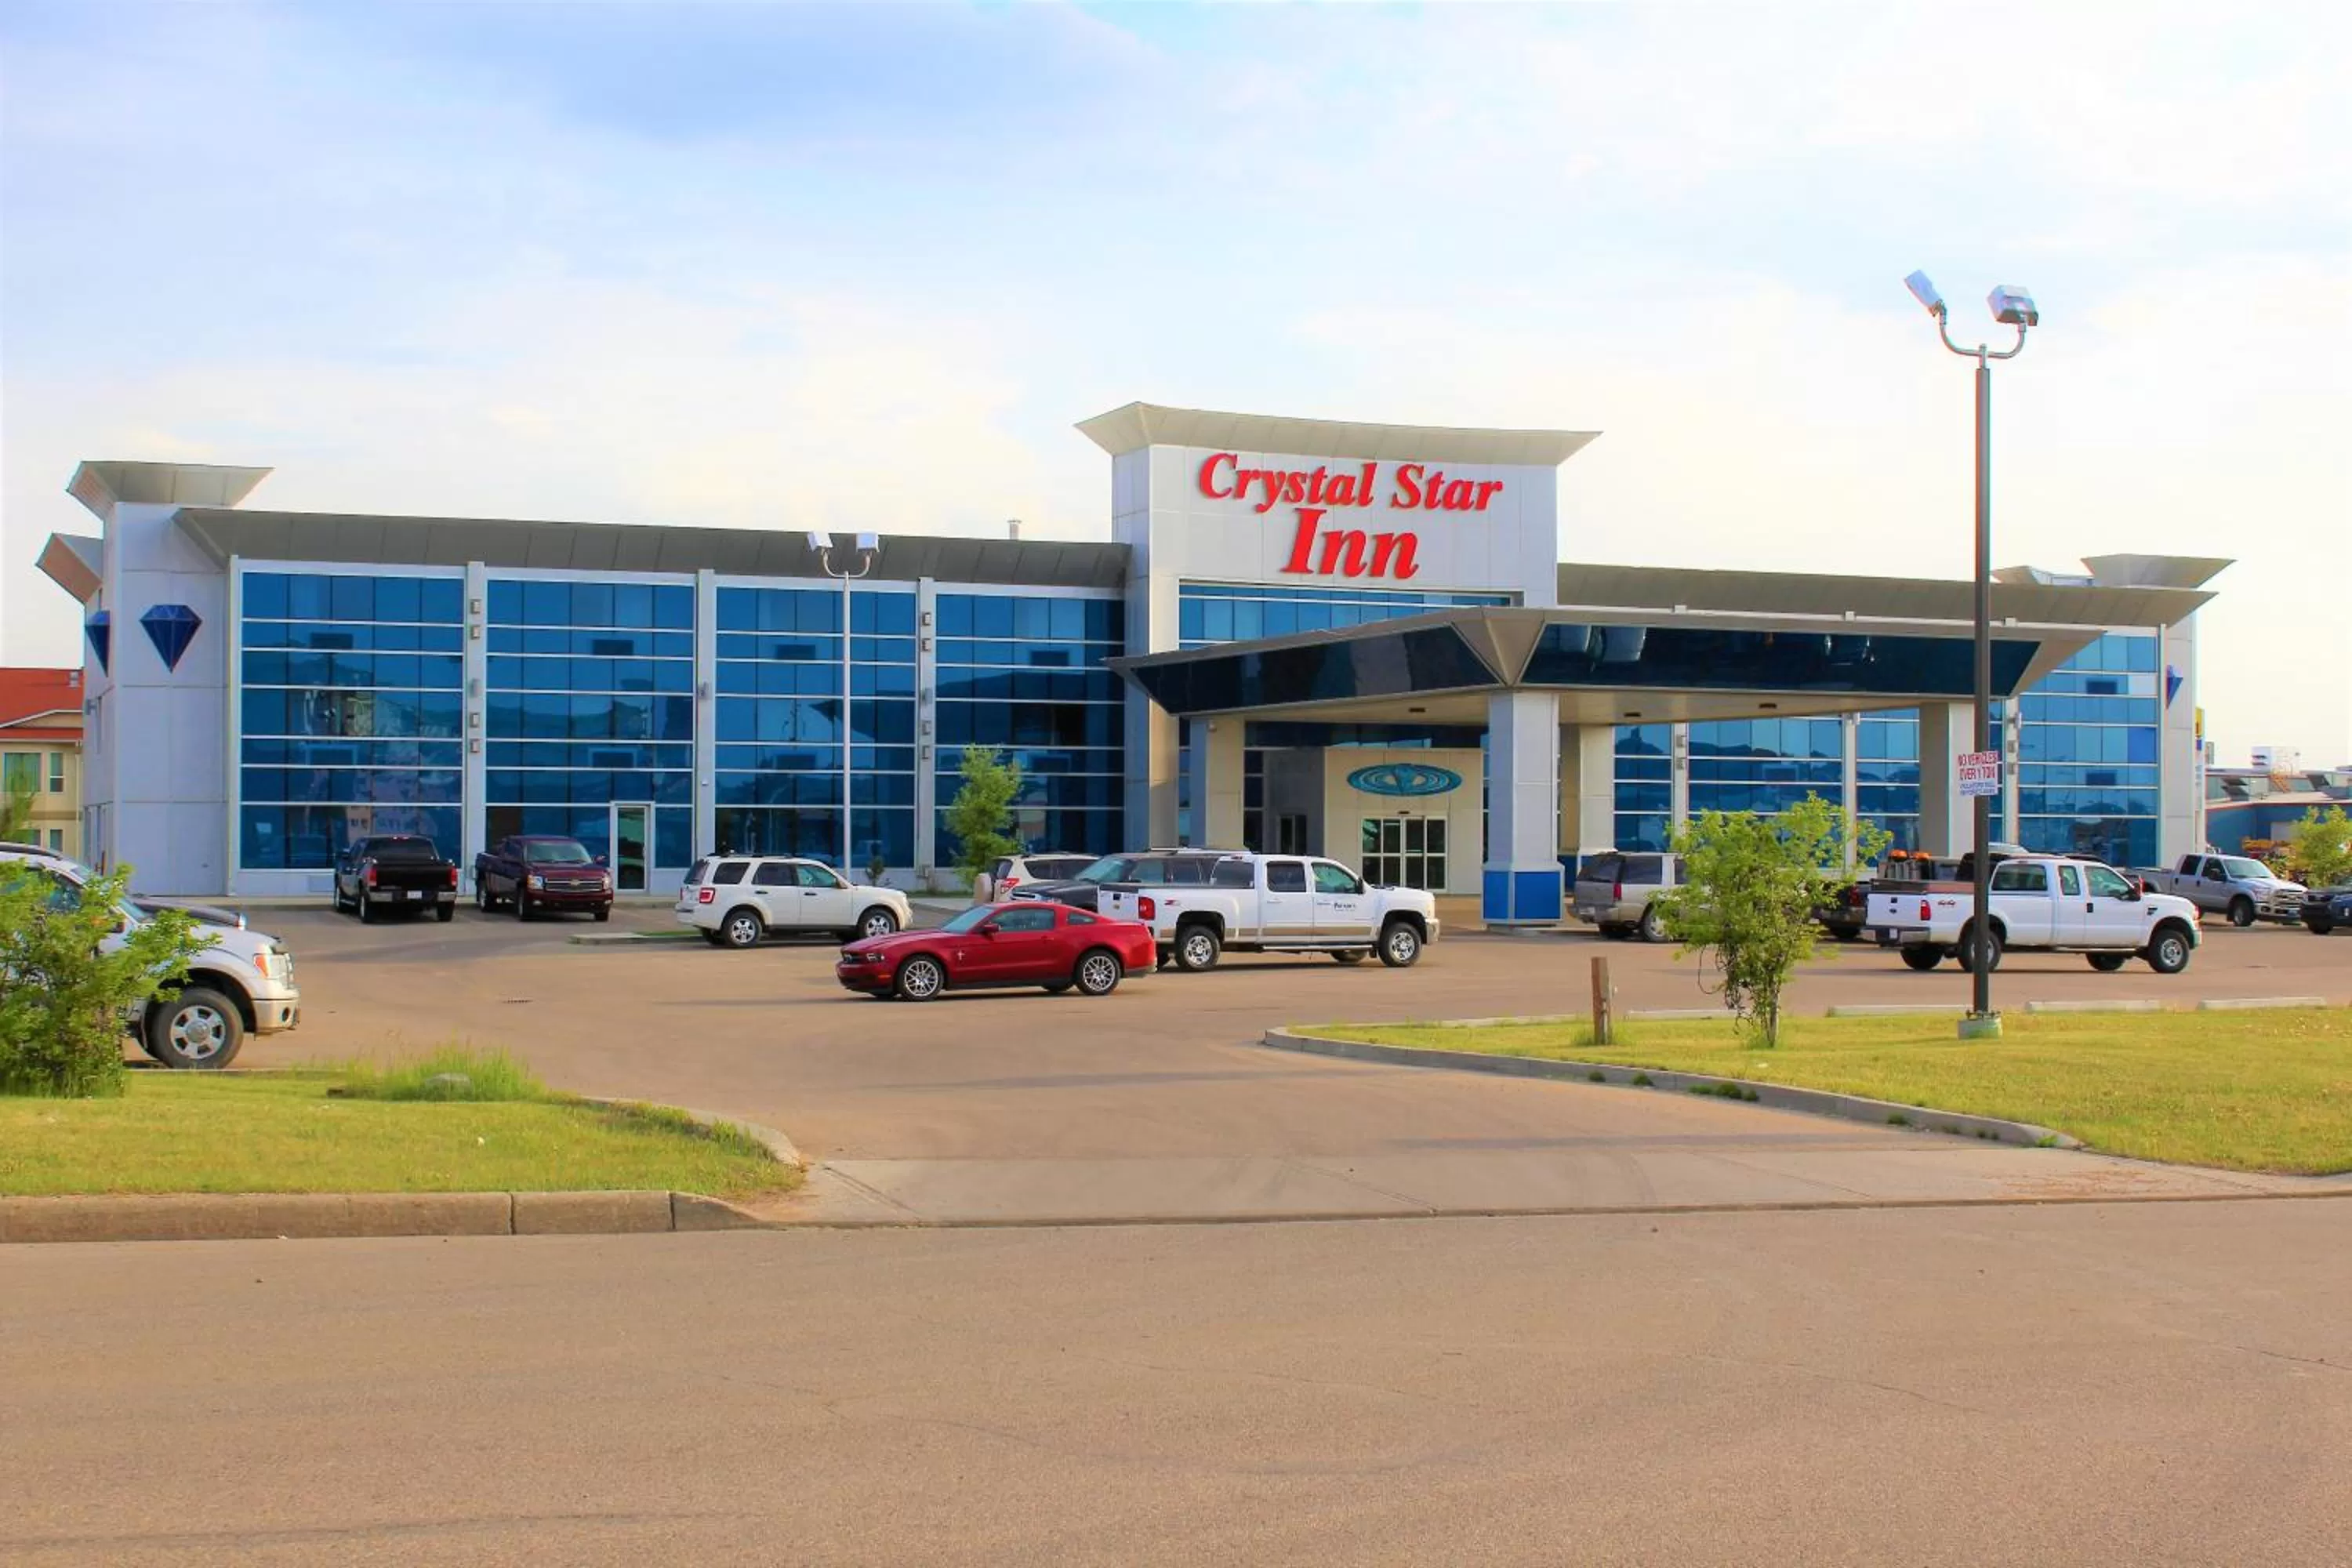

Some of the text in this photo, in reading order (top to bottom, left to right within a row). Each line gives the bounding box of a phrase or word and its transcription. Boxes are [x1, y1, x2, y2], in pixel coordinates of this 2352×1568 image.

[1198, 452, 1504, 514] Crystal Star
[1279, 507, 1420, 579] Inn
